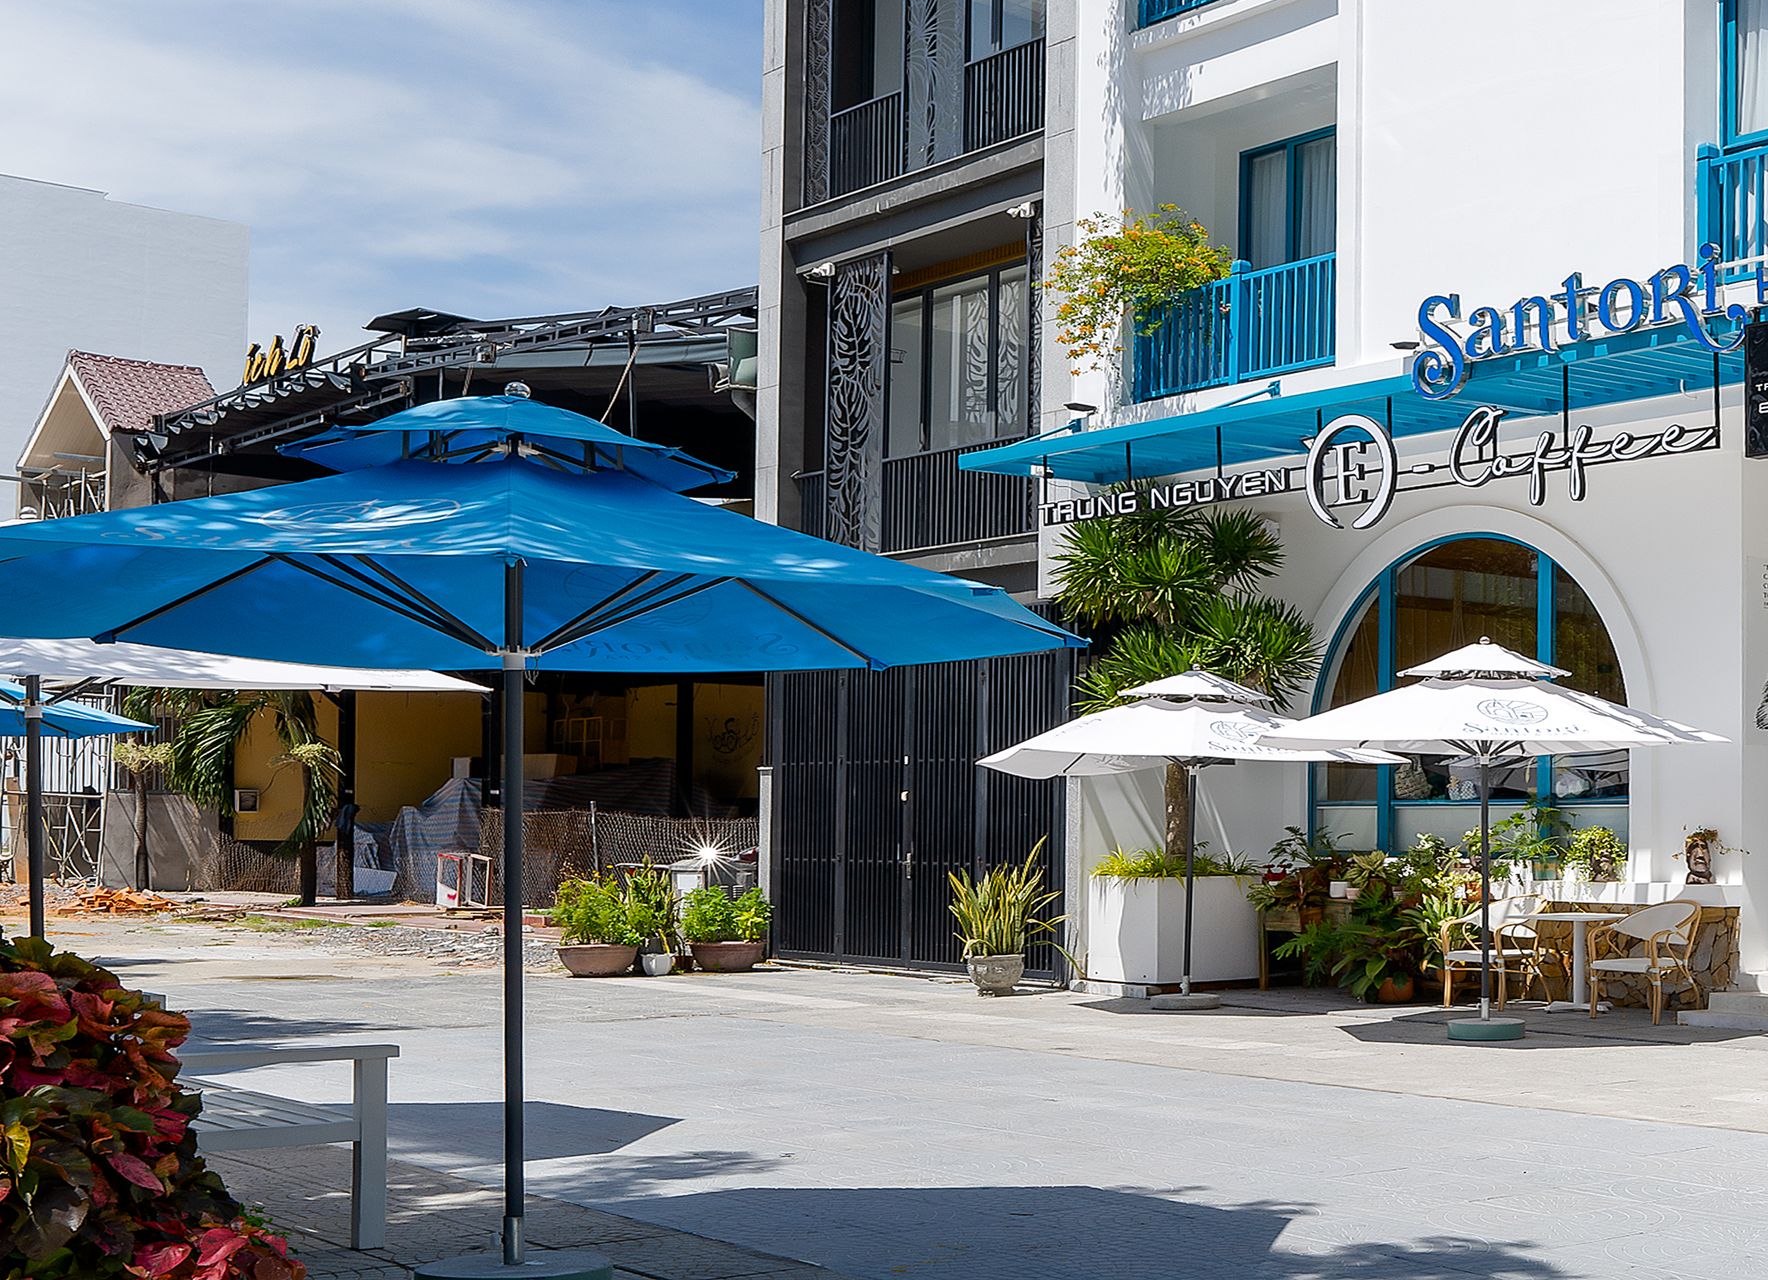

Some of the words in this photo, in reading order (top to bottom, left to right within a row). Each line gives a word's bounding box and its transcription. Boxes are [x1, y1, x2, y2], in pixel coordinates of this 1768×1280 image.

[1038, 490, 1138, 525] TRUNG
[1150, 467, 1287, 511] NGUYEN
[1449, 405, 1720, 506] Coffee
